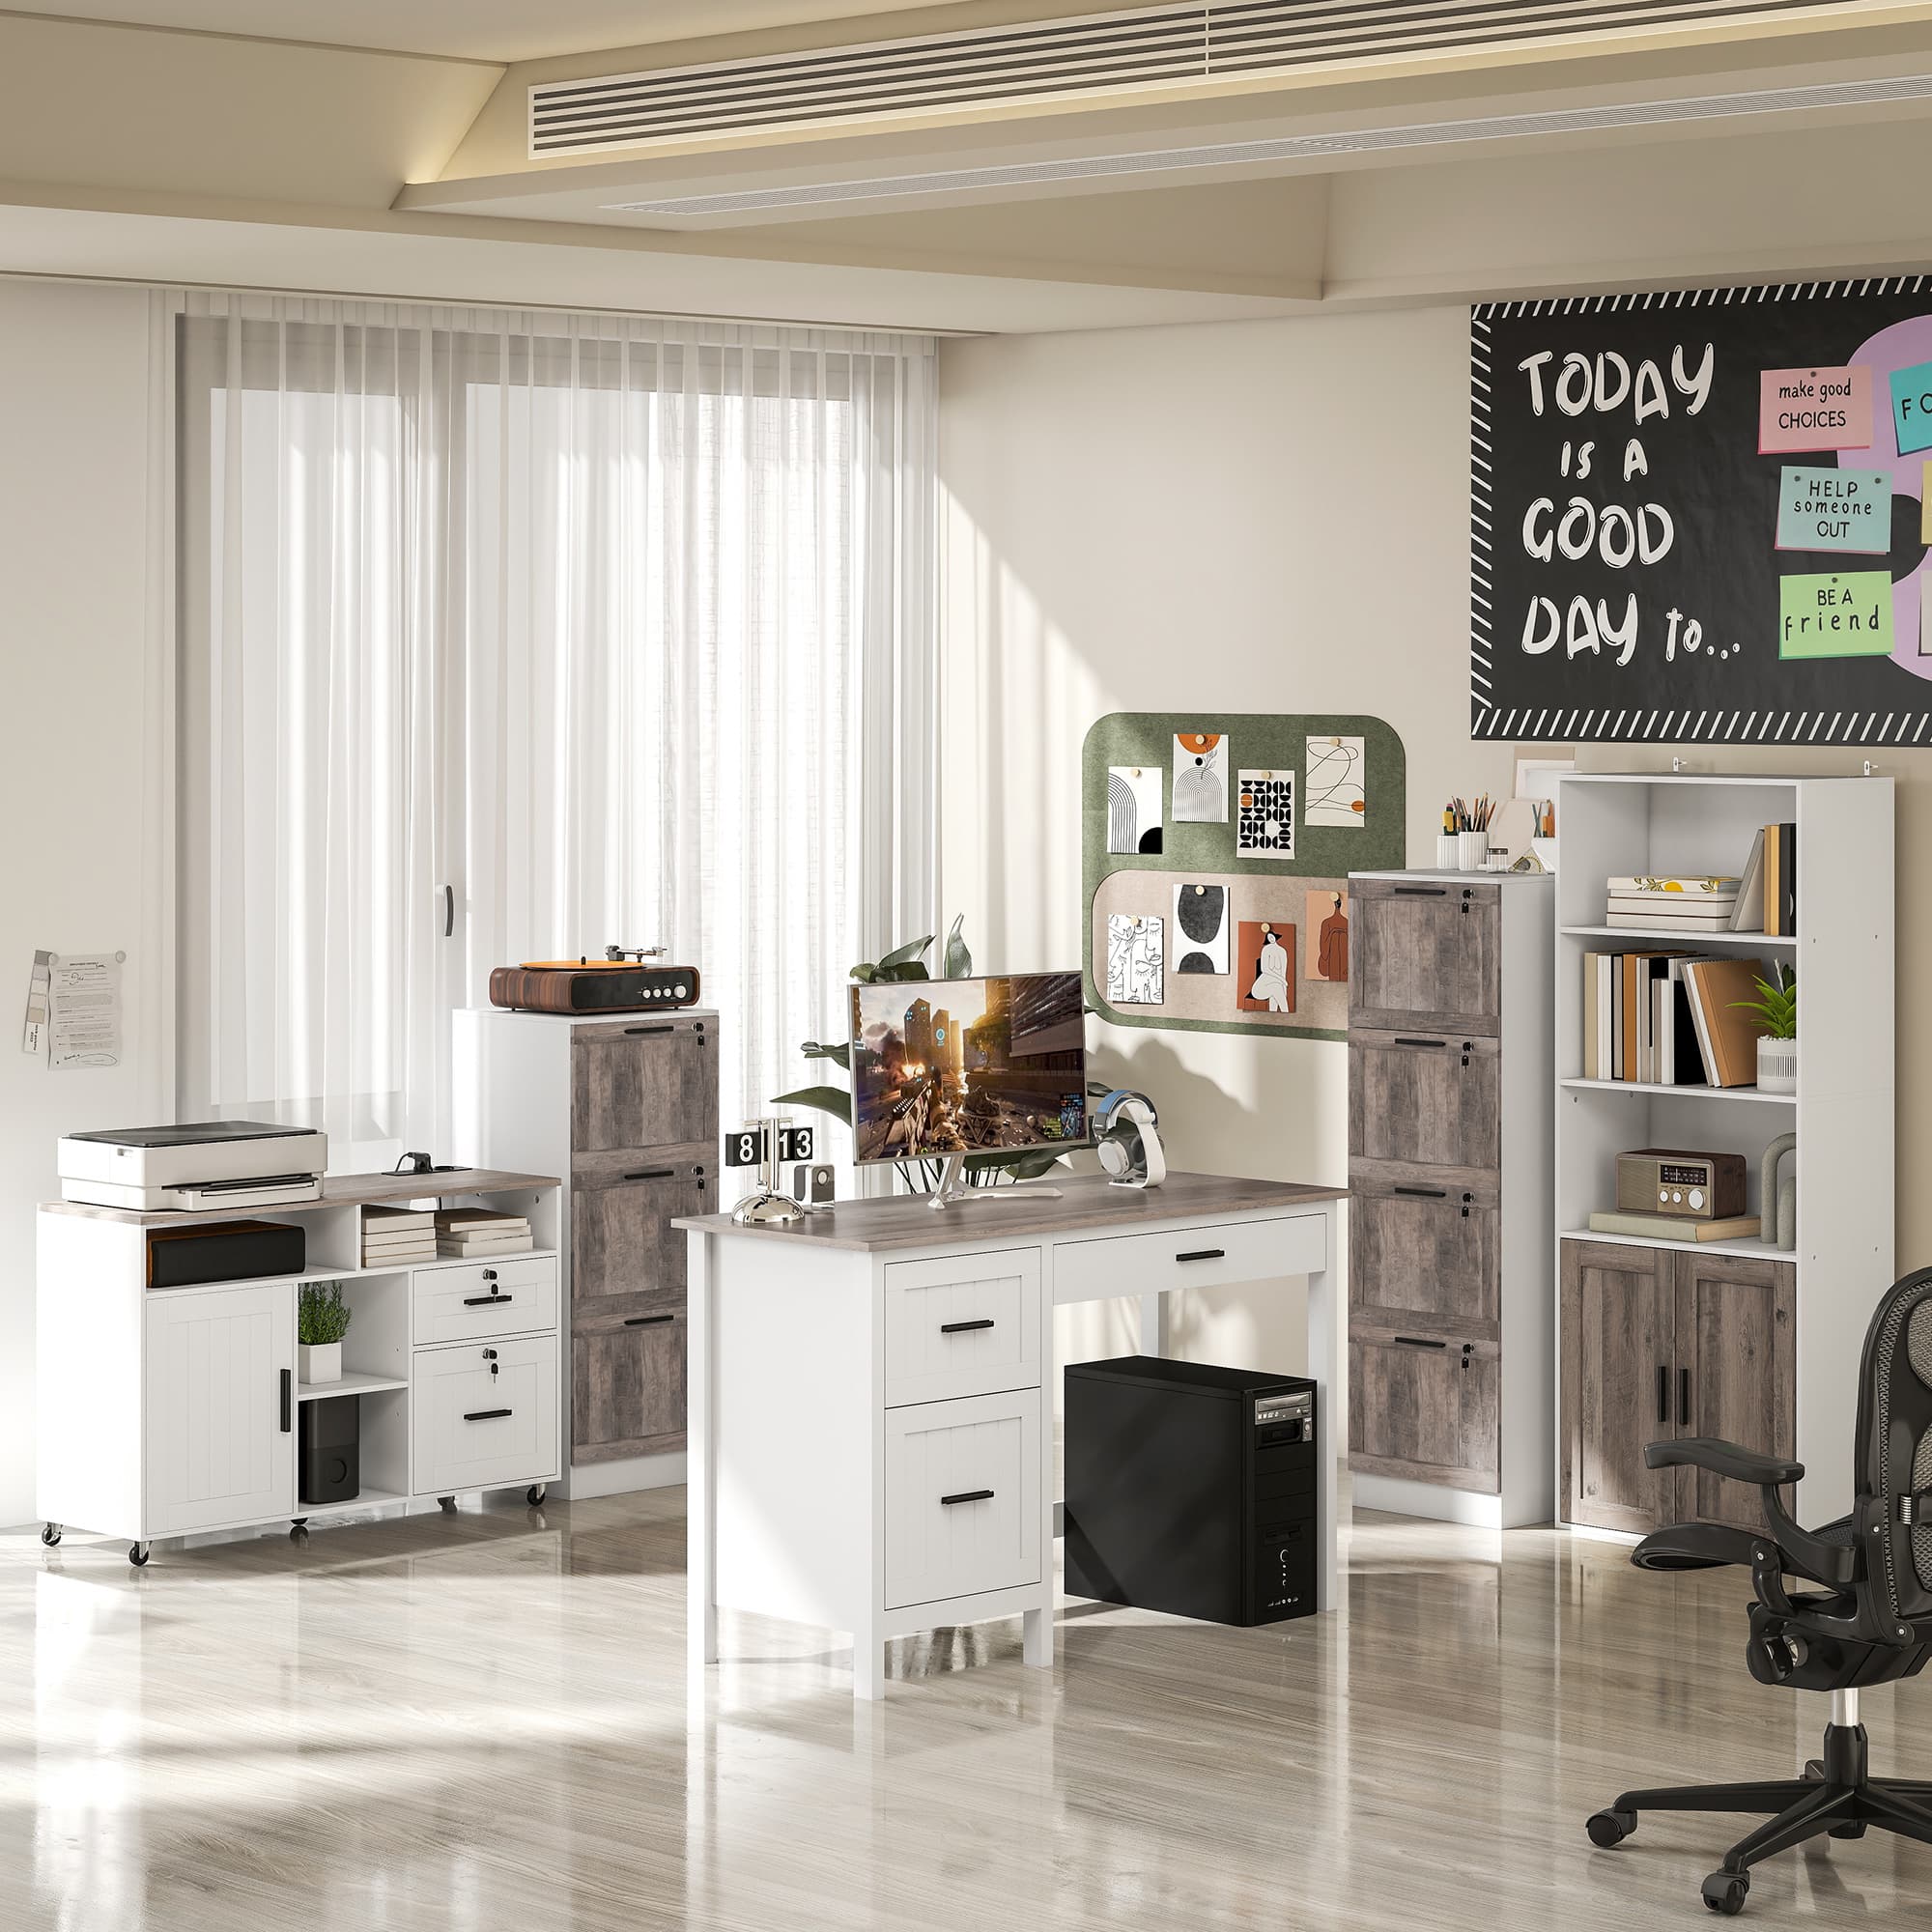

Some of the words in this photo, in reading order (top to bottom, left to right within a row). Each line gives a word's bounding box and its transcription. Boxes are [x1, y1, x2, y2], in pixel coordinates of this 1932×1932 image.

[1518, 342, 1715, 426] TODAY
[1778, 380, 1814, 399] make
[1819, 378, 1851, 404] good
[1778, 410, 1846, 429] CHOICES
[1623, 439, 1648, 482] A
[1809, 480, 1859, 497] HELP
[1793, 500, 1872, 515] someone
[1522, 496, 1675, 569] GOOD
[1816, 521, 1851, 538] OUT
[1817, 588, 1836, 607] BE
[1841, 588, 1853, 605] A
[1520, 592, 1639, 667] DAY
[1785, 605, 1879, 641] friend
[739, 1134, 754, 1162] 8
[779, 1129, 812, 1159] 13
